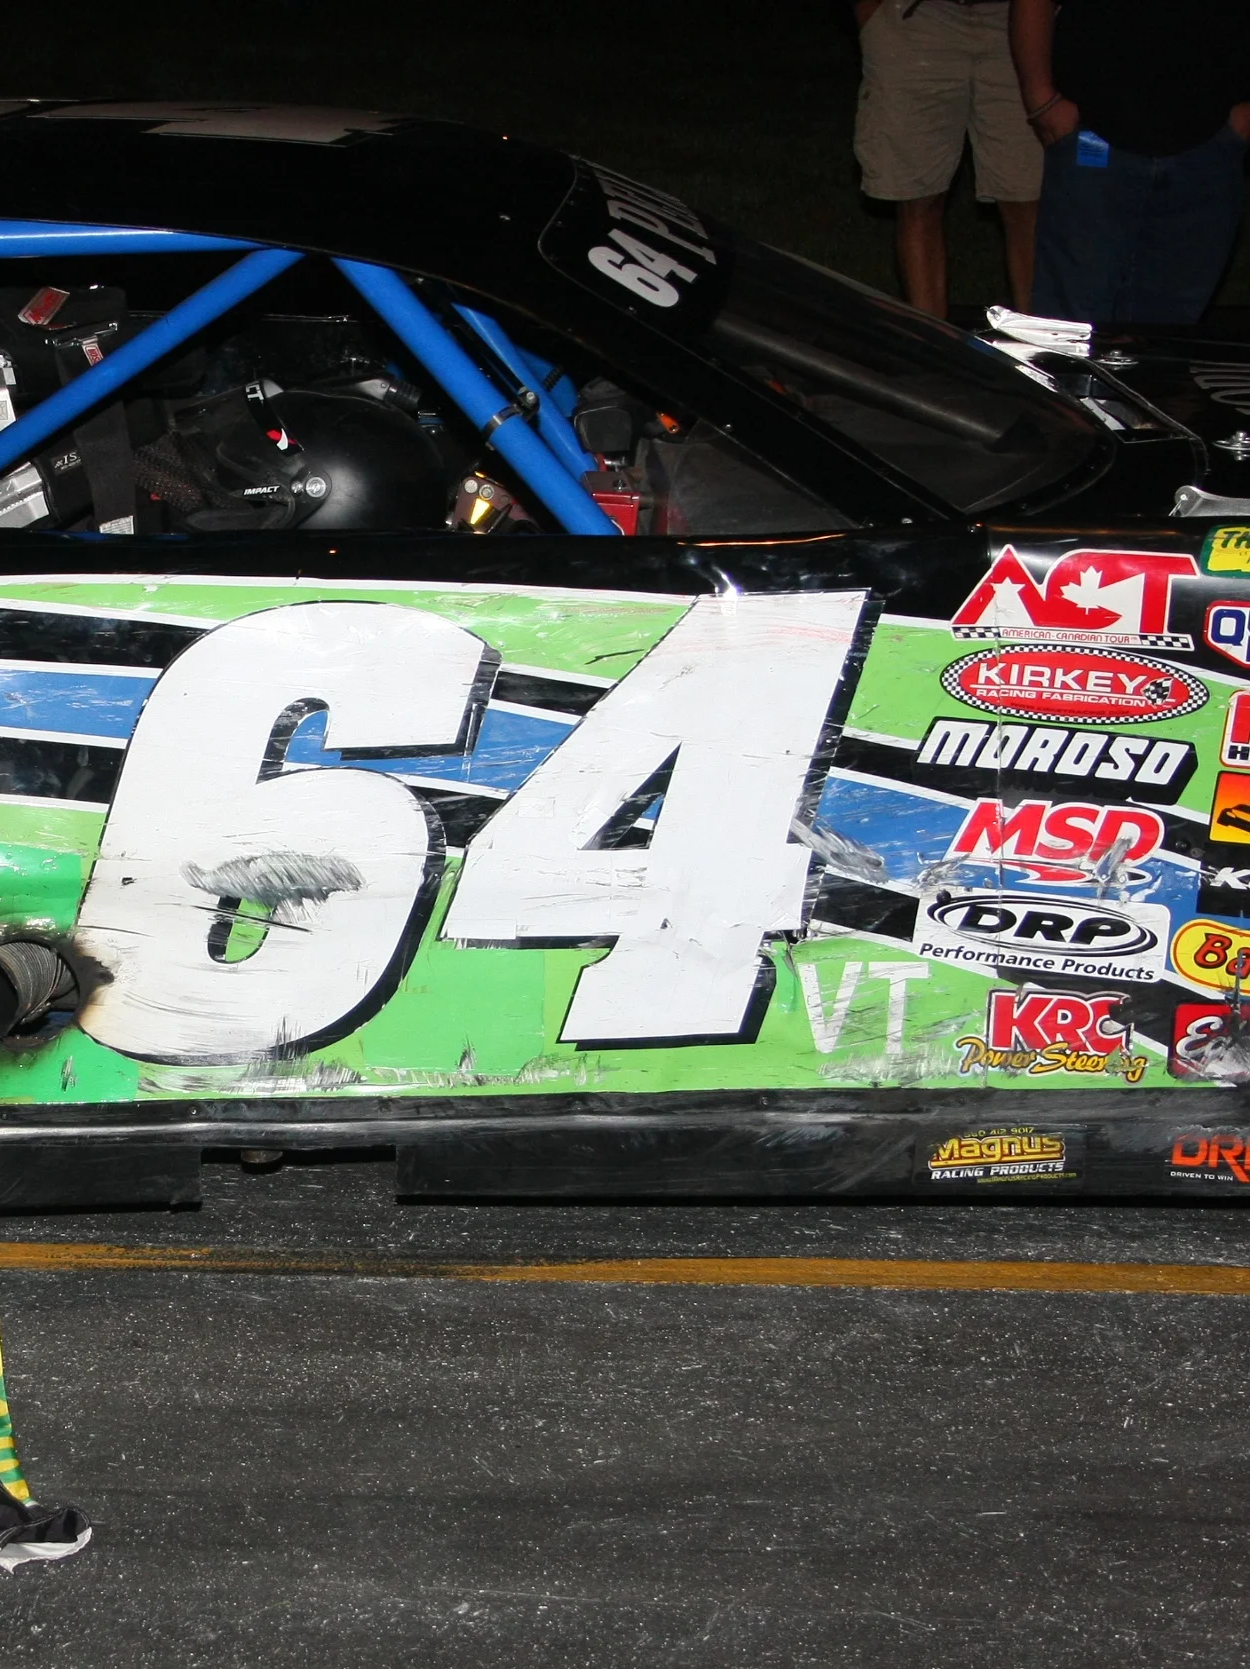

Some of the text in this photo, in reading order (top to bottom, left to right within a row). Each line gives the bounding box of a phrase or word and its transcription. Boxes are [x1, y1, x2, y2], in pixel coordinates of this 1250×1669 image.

[588, 228, 698, 308] 64
[244, 485, 280, 496] IMPACT
[951, 544, 1199, 635] ACT
[1105, 633, 1130, 644] TOUR
[1211, 608, 1250, 661] Q
[976, 689, 1145, 707] RACING FABRICATION
[977, 662, 1147, 695] KIRKEY
[917, 720, 1190, 785] MOROSO
[75, 588, 882, 1066] 64
[949, 799, 1163, 868] MSD
[1210, 867, 1250, 889] K
[957, 904, 1131, 945] DRP
[919, 943, 1155, 981] Performance Products
[796, 959, 929, 1054] VT
[990, 991, 1127, 1054] KRC
[956, 1036, 1147, 1082] Power Steerng
[934, 1135, 1064, 1160] Magnus
[931, 1162, 1065, 1180] RACING PRODUCTS
[1170, 1171, 1202, 1179] DRIVEN
